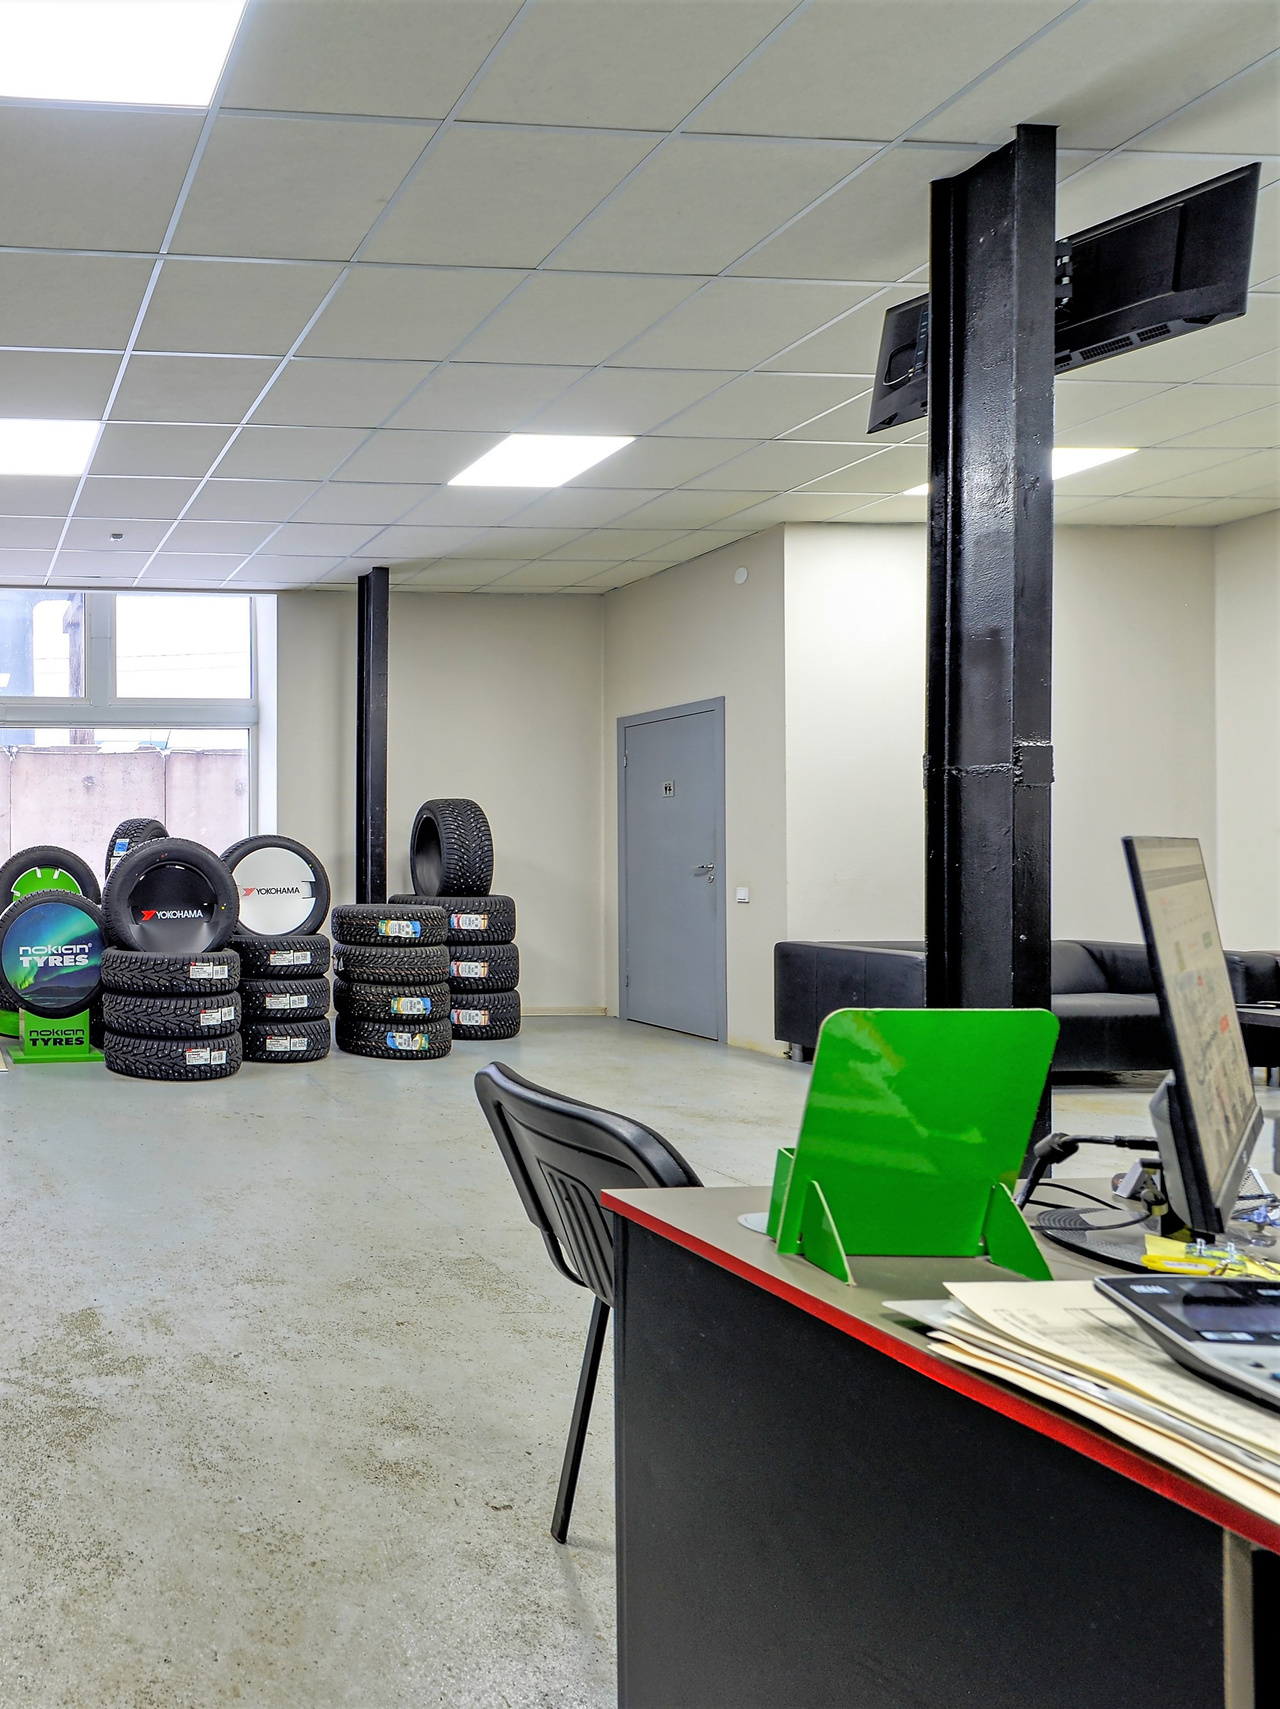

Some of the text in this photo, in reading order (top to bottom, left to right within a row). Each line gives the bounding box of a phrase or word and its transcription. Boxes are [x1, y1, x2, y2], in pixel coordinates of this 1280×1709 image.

[256, 886, 300, 896] YOKOHAMA
[155, 909, 204, 920] YOKOHAMA
[19, 954, 89, 967] TYRES
[29, 1036, 85, 1047] TYRES
